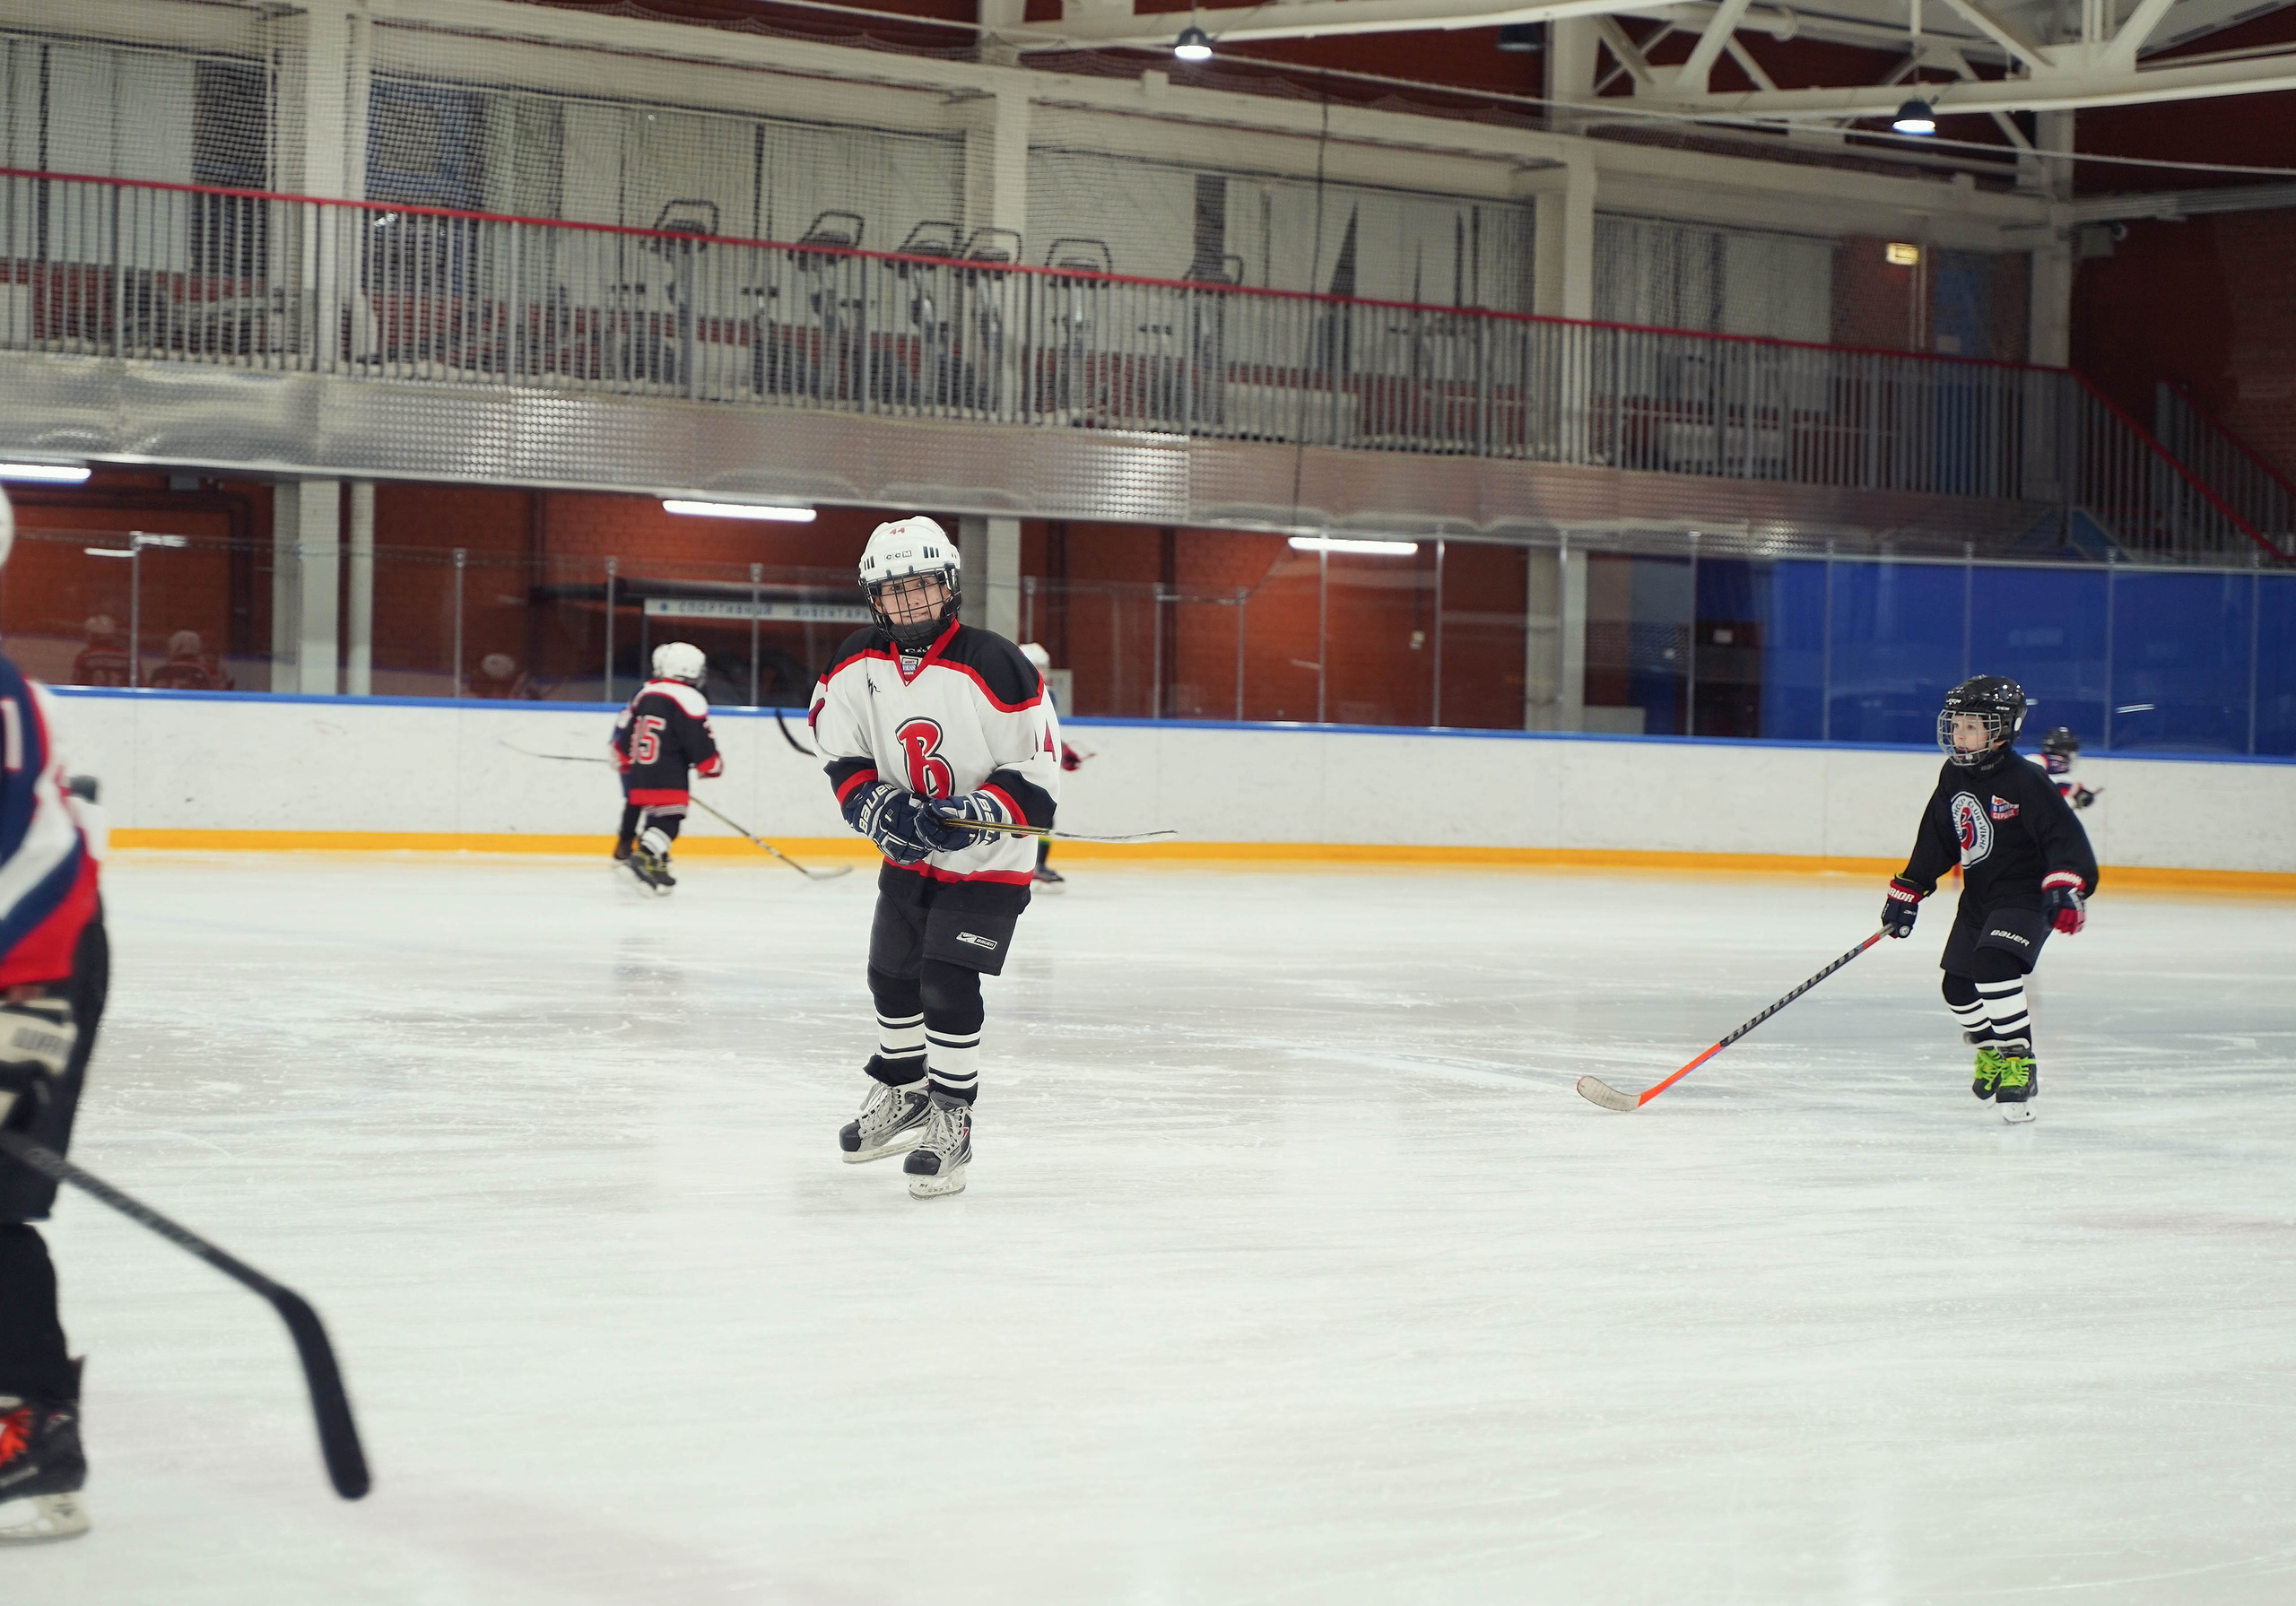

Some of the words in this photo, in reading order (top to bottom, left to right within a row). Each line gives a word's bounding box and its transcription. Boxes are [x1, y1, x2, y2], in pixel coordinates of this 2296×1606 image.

[885, 550, 912, 560] CCM
[631, 715, 666, 764] 15
[858, 782, 896, 834] BAUER
[977, 797, 996, 846] BAU
[1888, 887, 1916, 903] RIOR
[1990, 929, 2031, 947] BAUER
